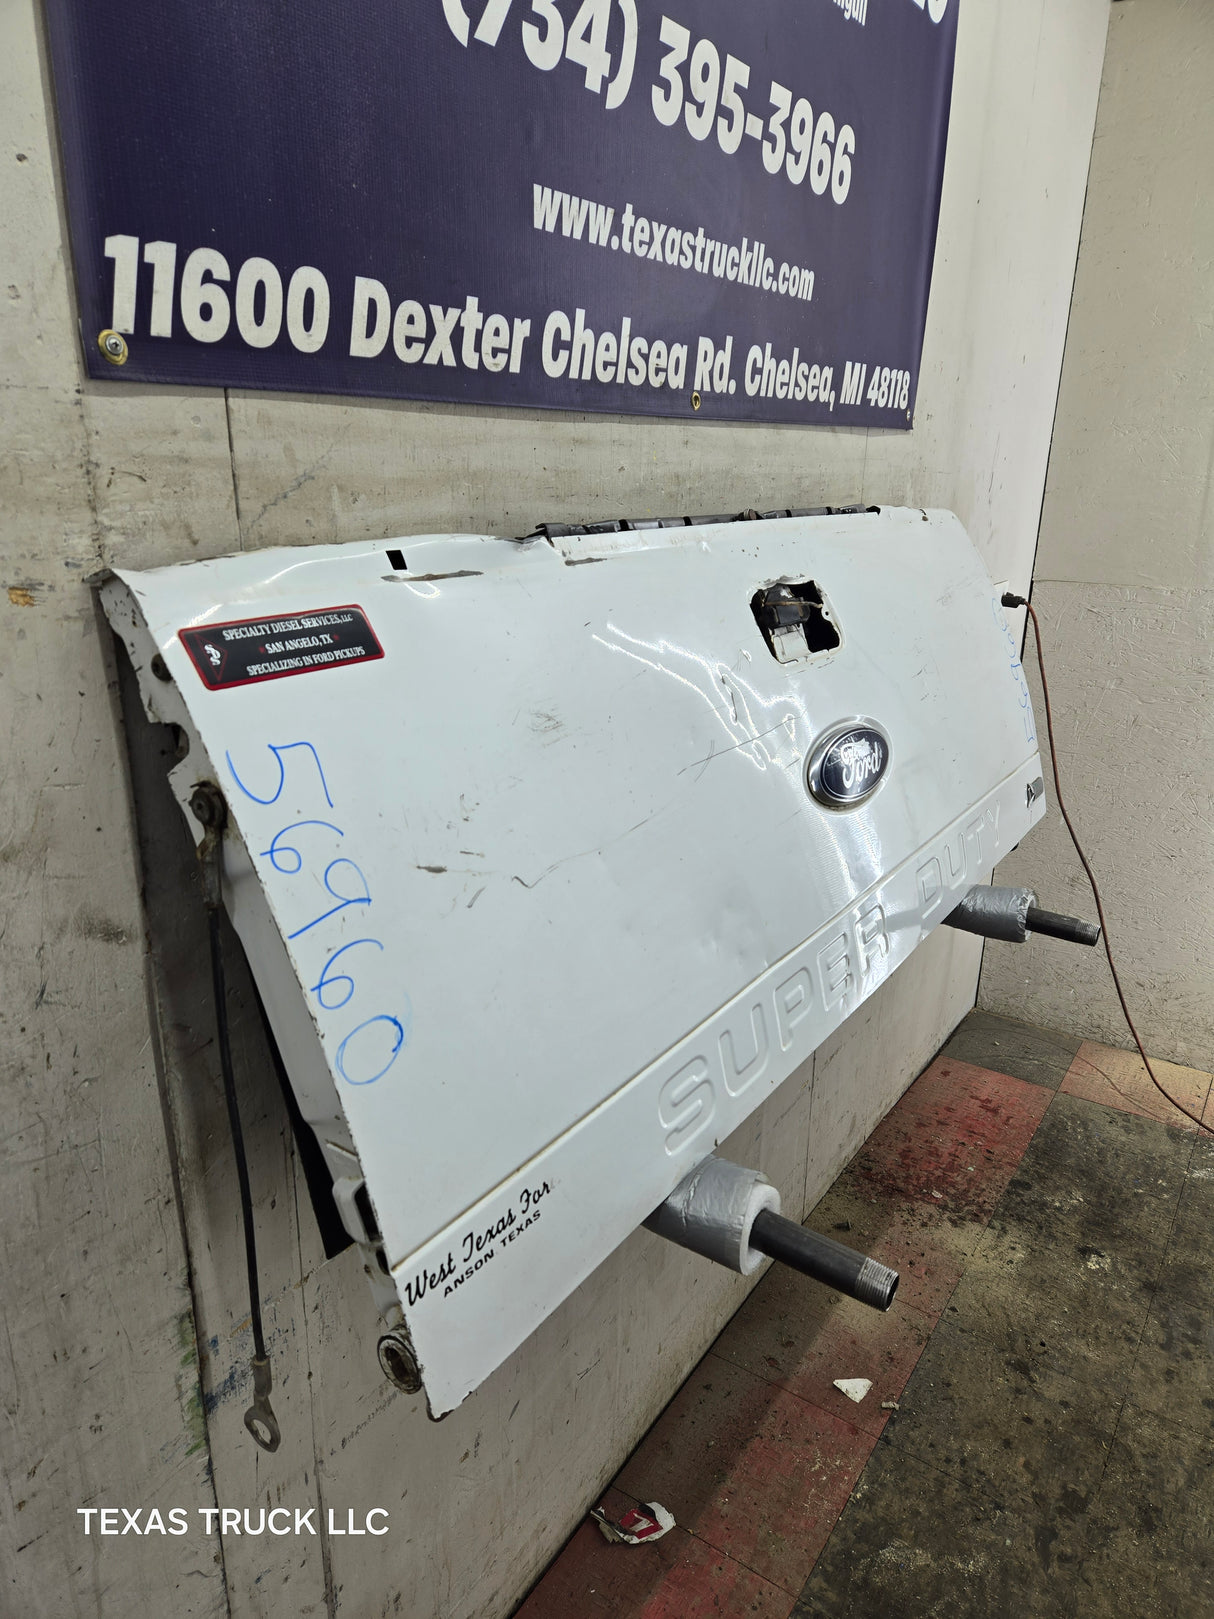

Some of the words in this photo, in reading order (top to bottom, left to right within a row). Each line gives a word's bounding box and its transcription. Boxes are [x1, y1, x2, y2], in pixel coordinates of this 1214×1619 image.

[652, 15, 856, 205] 395-3966
[533, 184, 815, 301] www.texastruckllc.com
[104, 234, 331, 353] 11600
[349, 275, 531, 373] Dexter
[542, 308, 688, 390] Chelsea
[693, 335, 736, 395] Rd.
[744, 342, 836, 412] Chelsea,
[839, 360, 867, 405] MI
[867, 366, 910, 410] 48118
[222, 624, 271, 641] SPECIALTY
[272, 619, 302, 634] DIESEL
[247, 657, 304, 676] SPECIALIZING
[303, 655, 313, 666] IN
[313, 651, 335, 664] FORD
[333, 646, 366, 661] PICKUPS
[264, 642, 285, 654] SAN
[320, 634, 333, 645] TX
[840, 741, 883, 788] Ford
[226, 741, 405, 1086] 56960
[658, 902, 891, 1156] SUPER
[915, 799, 1001, 919] DUTY
[405, 1252, 456, 1307] West
[463, 1208, 516, 1262] Texas
[444, 1249, 495, 1298] ANSON
[500, 1210, 541, 1247] TEXAS
